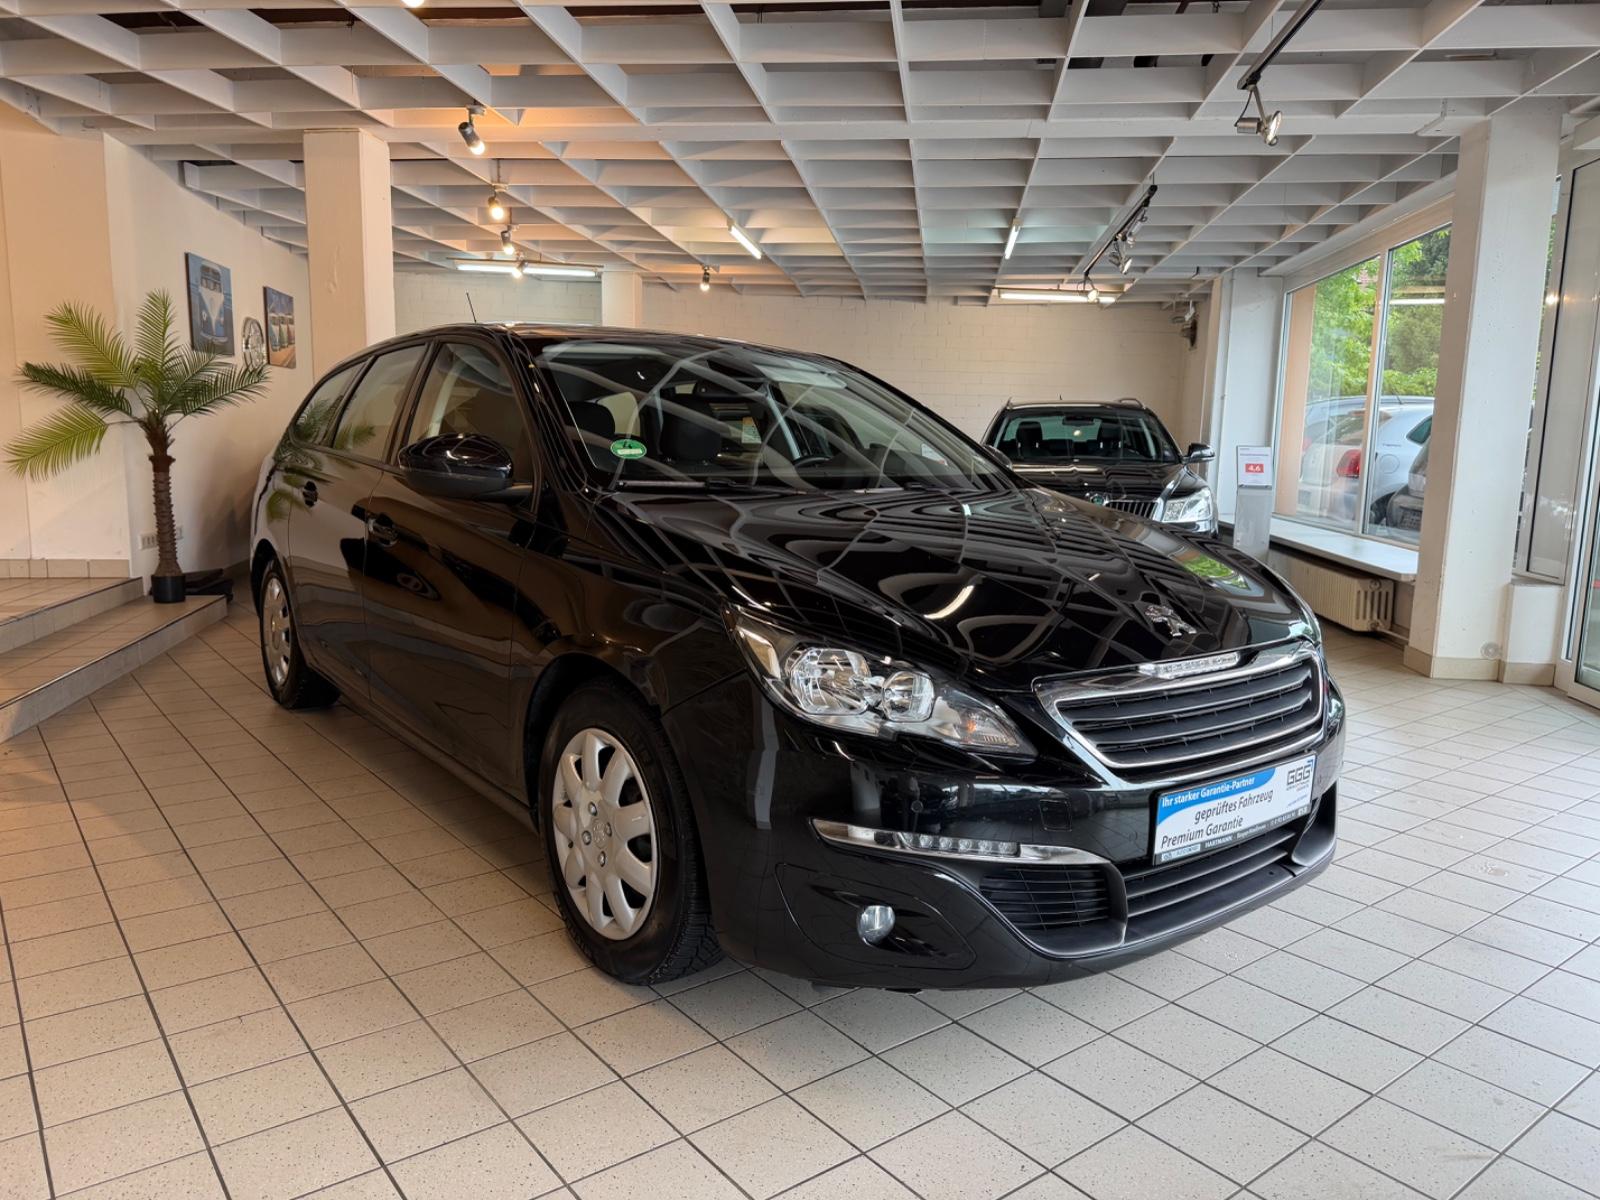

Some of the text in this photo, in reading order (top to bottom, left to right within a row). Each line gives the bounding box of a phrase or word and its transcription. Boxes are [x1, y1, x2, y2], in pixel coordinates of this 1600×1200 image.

[1287, 763, 1312, 785] GGG
[1162, 777, 1255, 807] Ihr starker Garantie-Partner
[1194, 800, 1237, 824] geprüftes
[1238, 789, 1273, 809] Fahrzeug
[1161, 828, 1204, 849] Premium
[1206, 815, 1243, 836] Garantie
